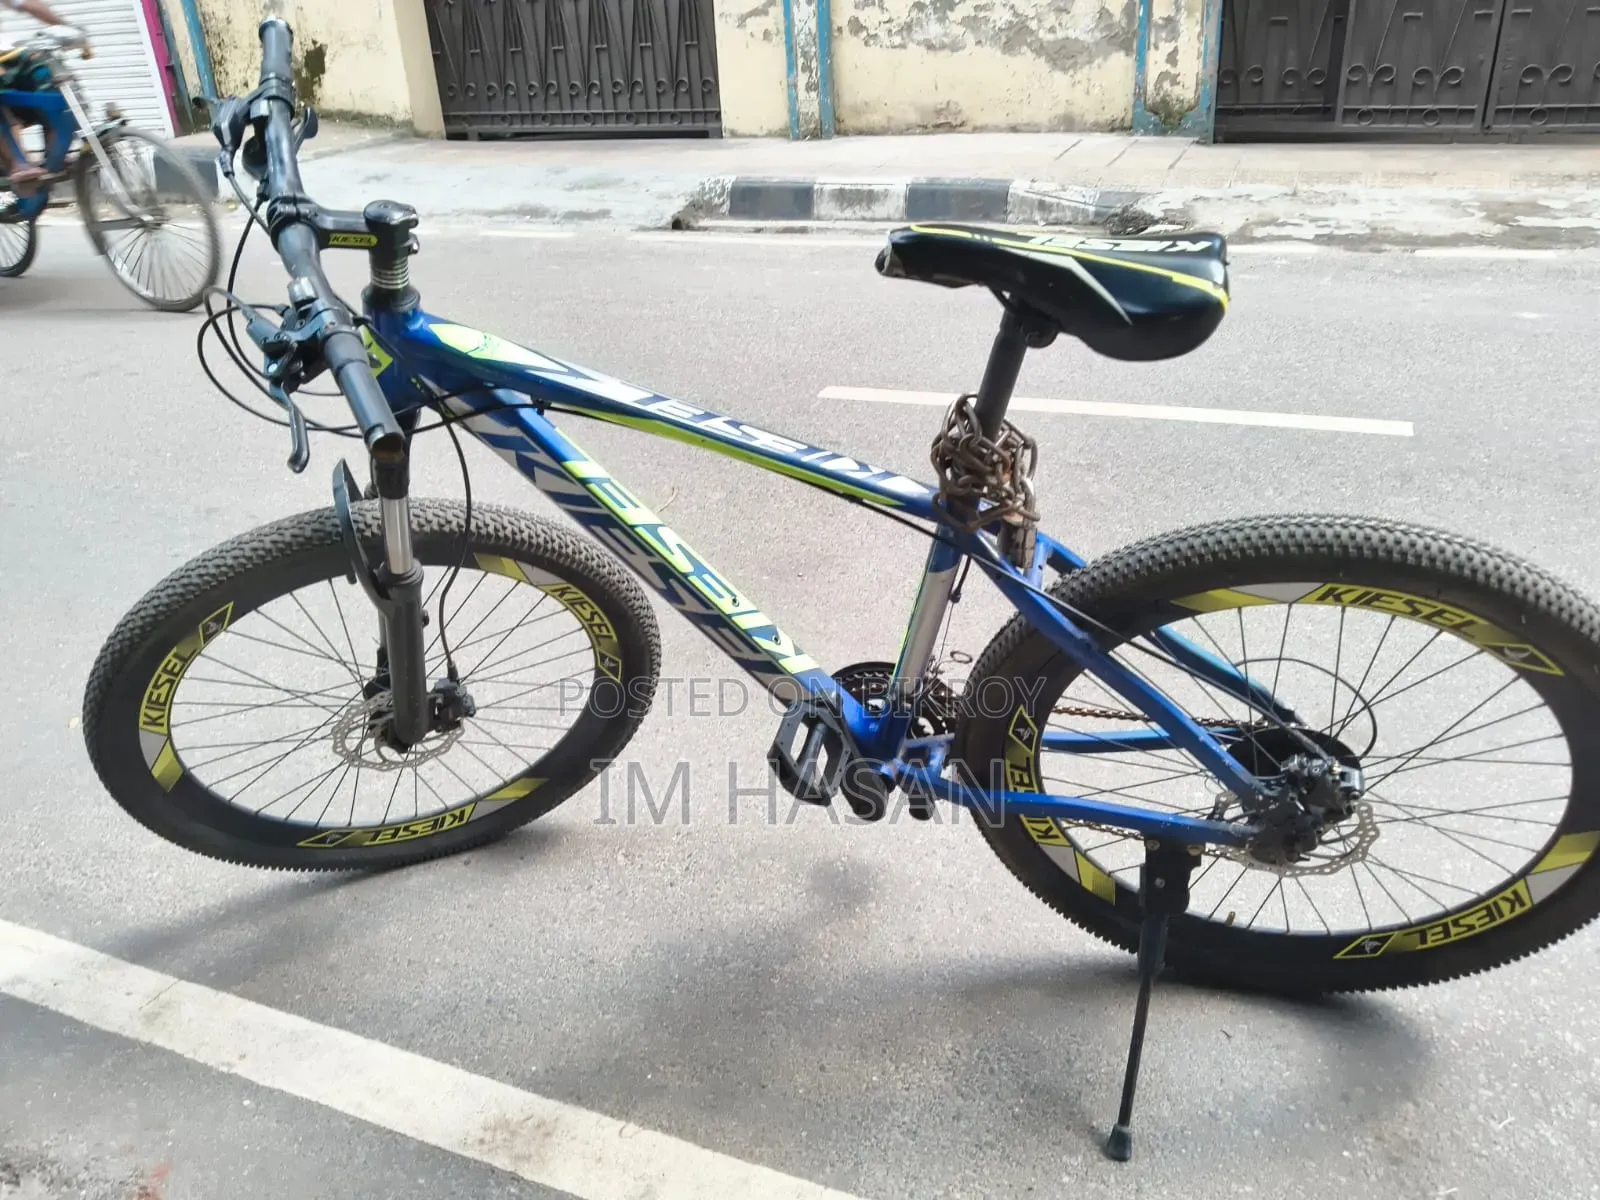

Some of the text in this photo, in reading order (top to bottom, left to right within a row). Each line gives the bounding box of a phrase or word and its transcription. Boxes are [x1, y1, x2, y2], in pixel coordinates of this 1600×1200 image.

[477, 422, 786, 698] KIESEL
[555, 425, 822, 676] KIESEL
[550, 586, 614, 646] KIESEL
[1315, 586, 1477, 640] KIESEL
[142, 648, 197, 727] KIESEL
[360, 808, 466, 843] KIESEL
[1010, 757, 1060, 839] KIEL
[1403, 888, 1526, 945] KIESEL
